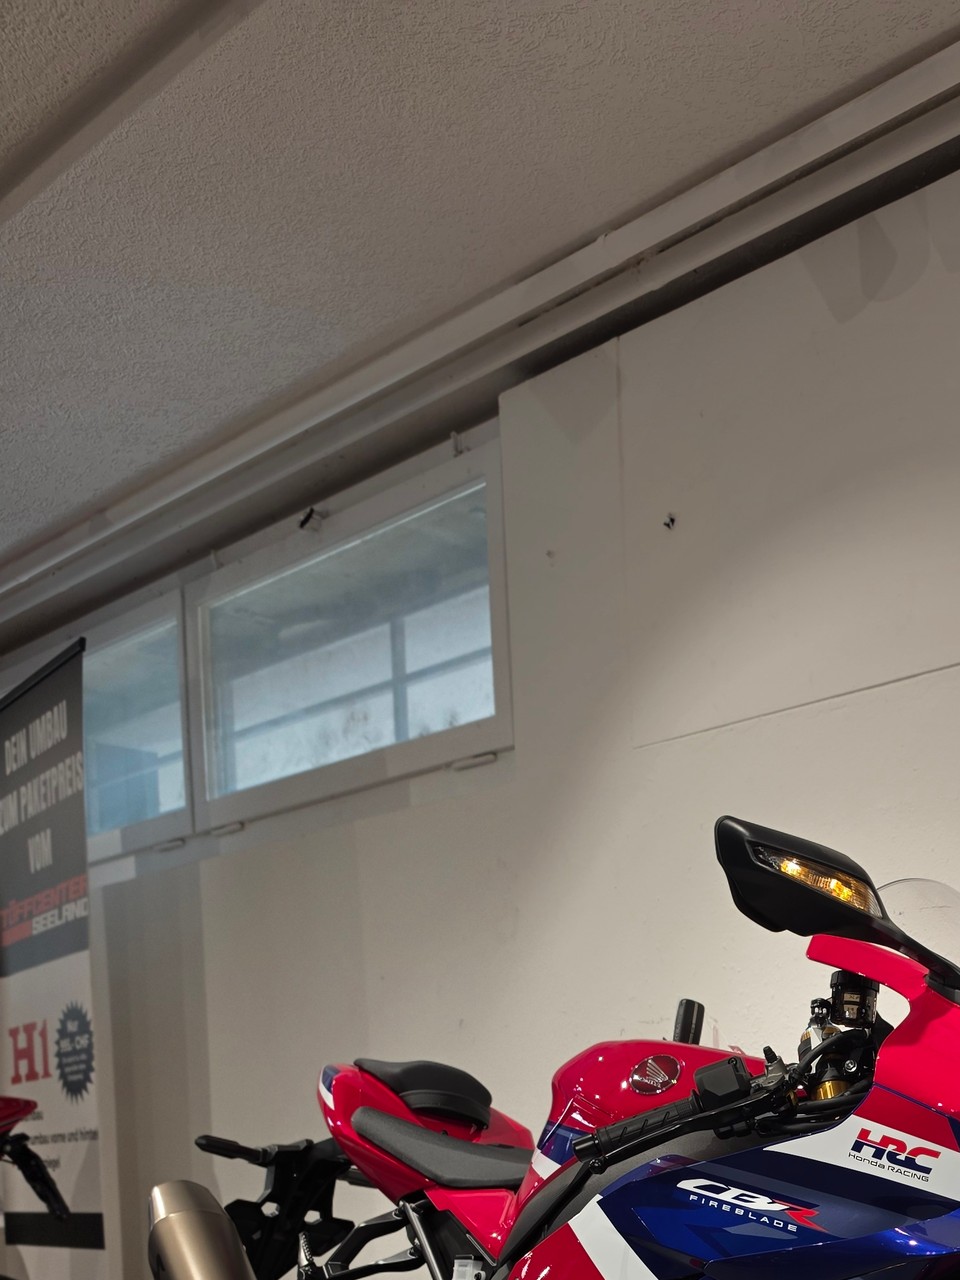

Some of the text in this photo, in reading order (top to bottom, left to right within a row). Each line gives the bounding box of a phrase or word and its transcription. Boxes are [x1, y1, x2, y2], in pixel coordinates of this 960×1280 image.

[4, 699, 68, 776] DEIN UMBAU
[19, 750, 84, 824] PAKETPREIS
[850, 1127, 942, 1175] HRC
[887, 1164, 930, 1183] RACING
[676, 1178, 829, 1233] CBR
[689, 1194, 798, 1233] FIREBLADE
